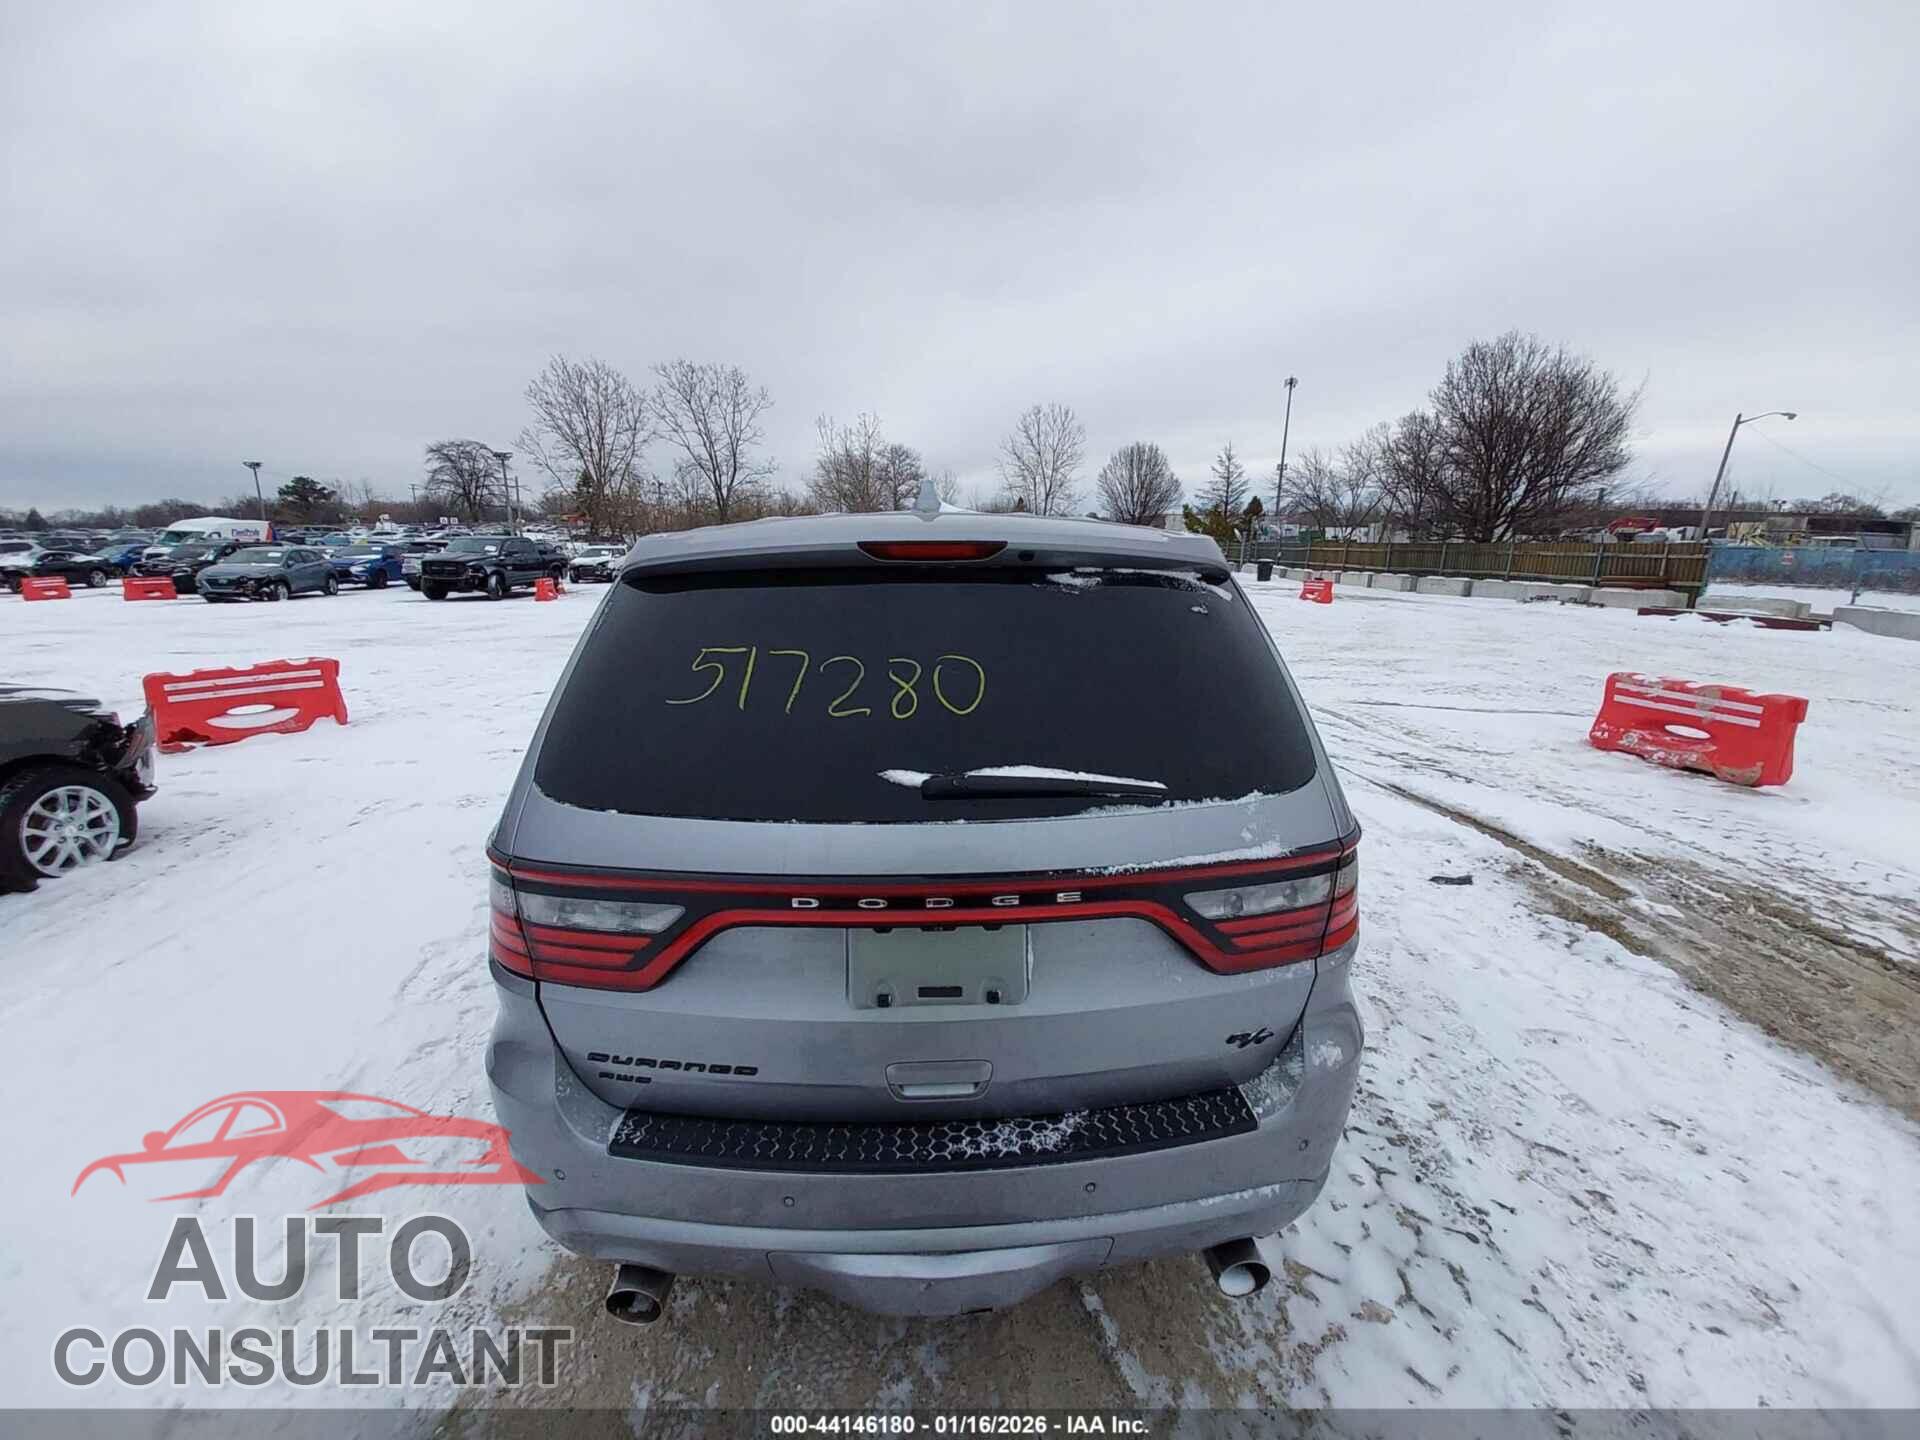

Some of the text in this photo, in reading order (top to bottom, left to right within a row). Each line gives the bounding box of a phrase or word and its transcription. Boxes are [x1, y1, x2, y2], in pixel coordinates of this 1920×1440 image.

[665, 646, 985, 718] 517280
[791, 891, 1082, 908] DODGE
[587, 1052, 759, 1076] DURANGO
